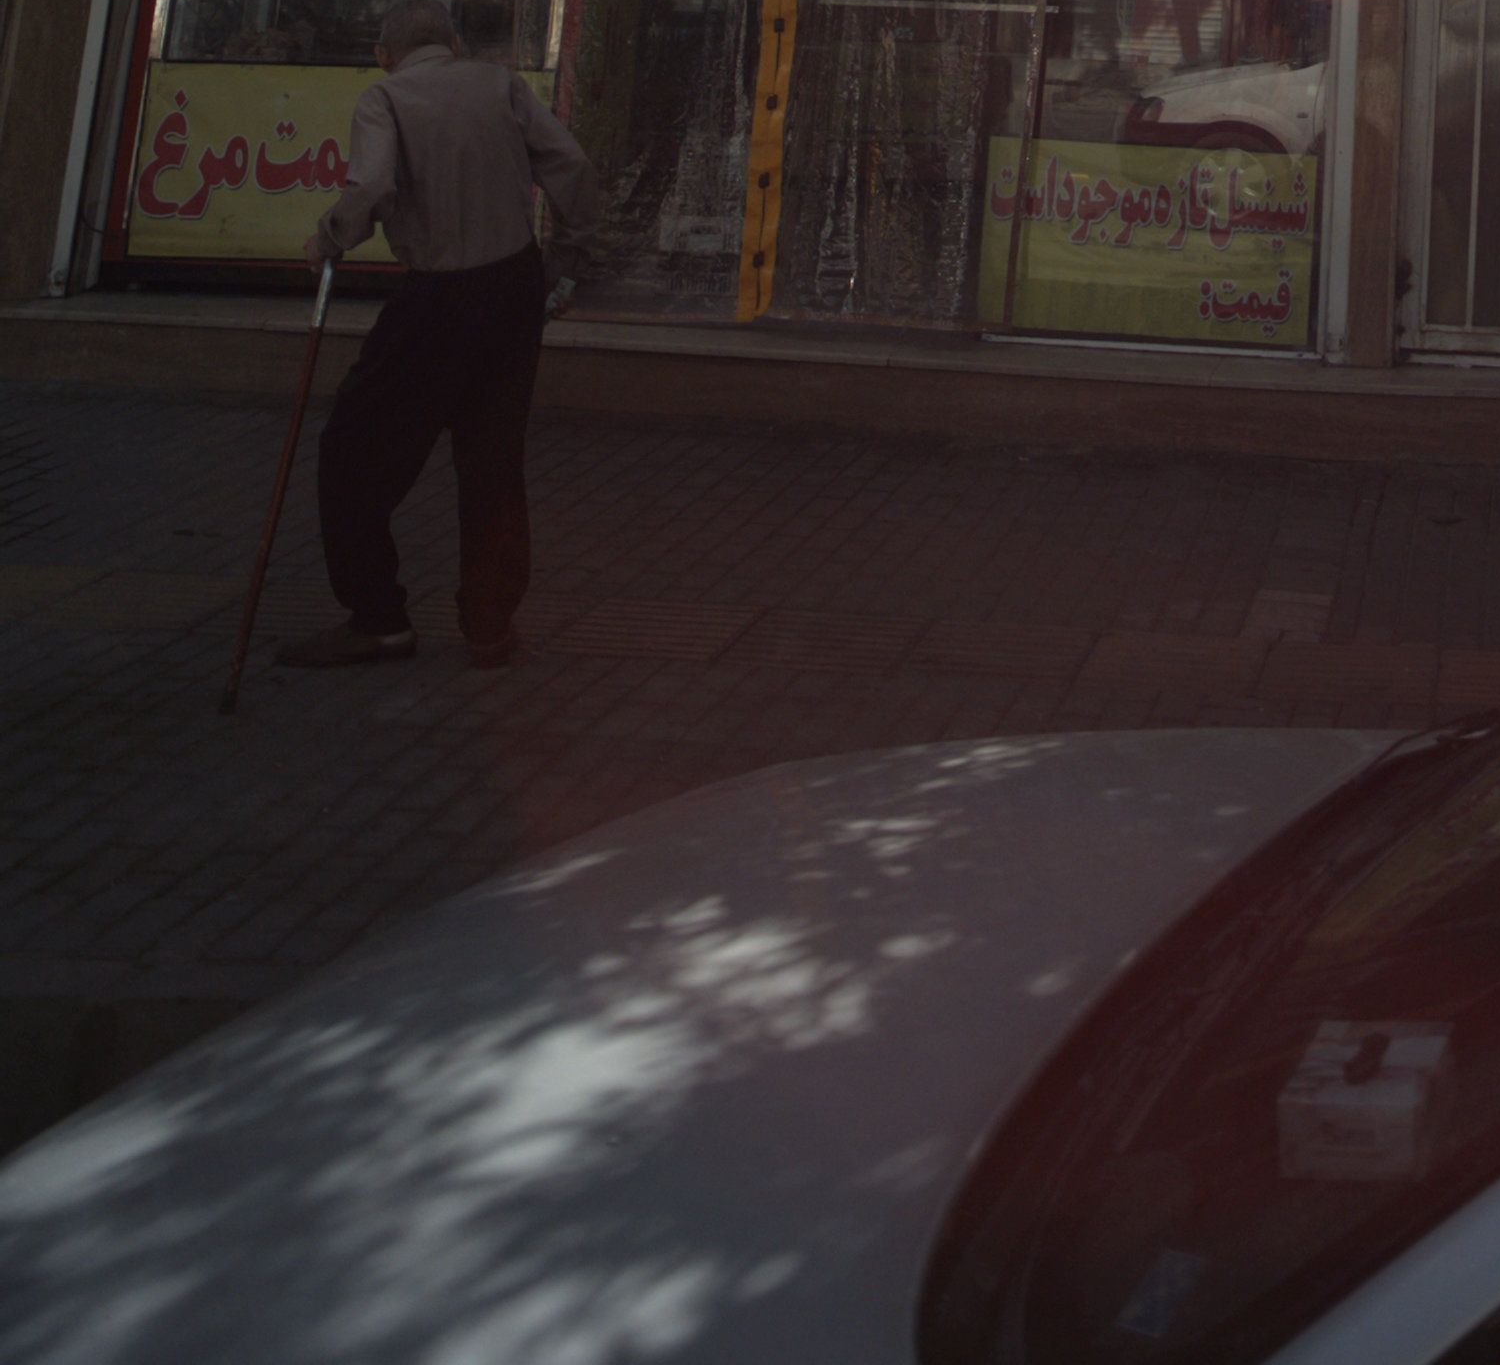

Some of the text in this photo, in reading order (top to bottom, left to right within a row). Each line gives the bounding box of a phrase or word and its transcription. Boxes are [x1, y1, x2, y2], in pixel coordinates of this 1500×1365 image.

[137, 88, 351, 218] مت مرغ
[1053, 168, 1152, 247] موجود
[1152, 162, 1213, 250] تازه
[1199, 268, 1293, 337] قیمت:
